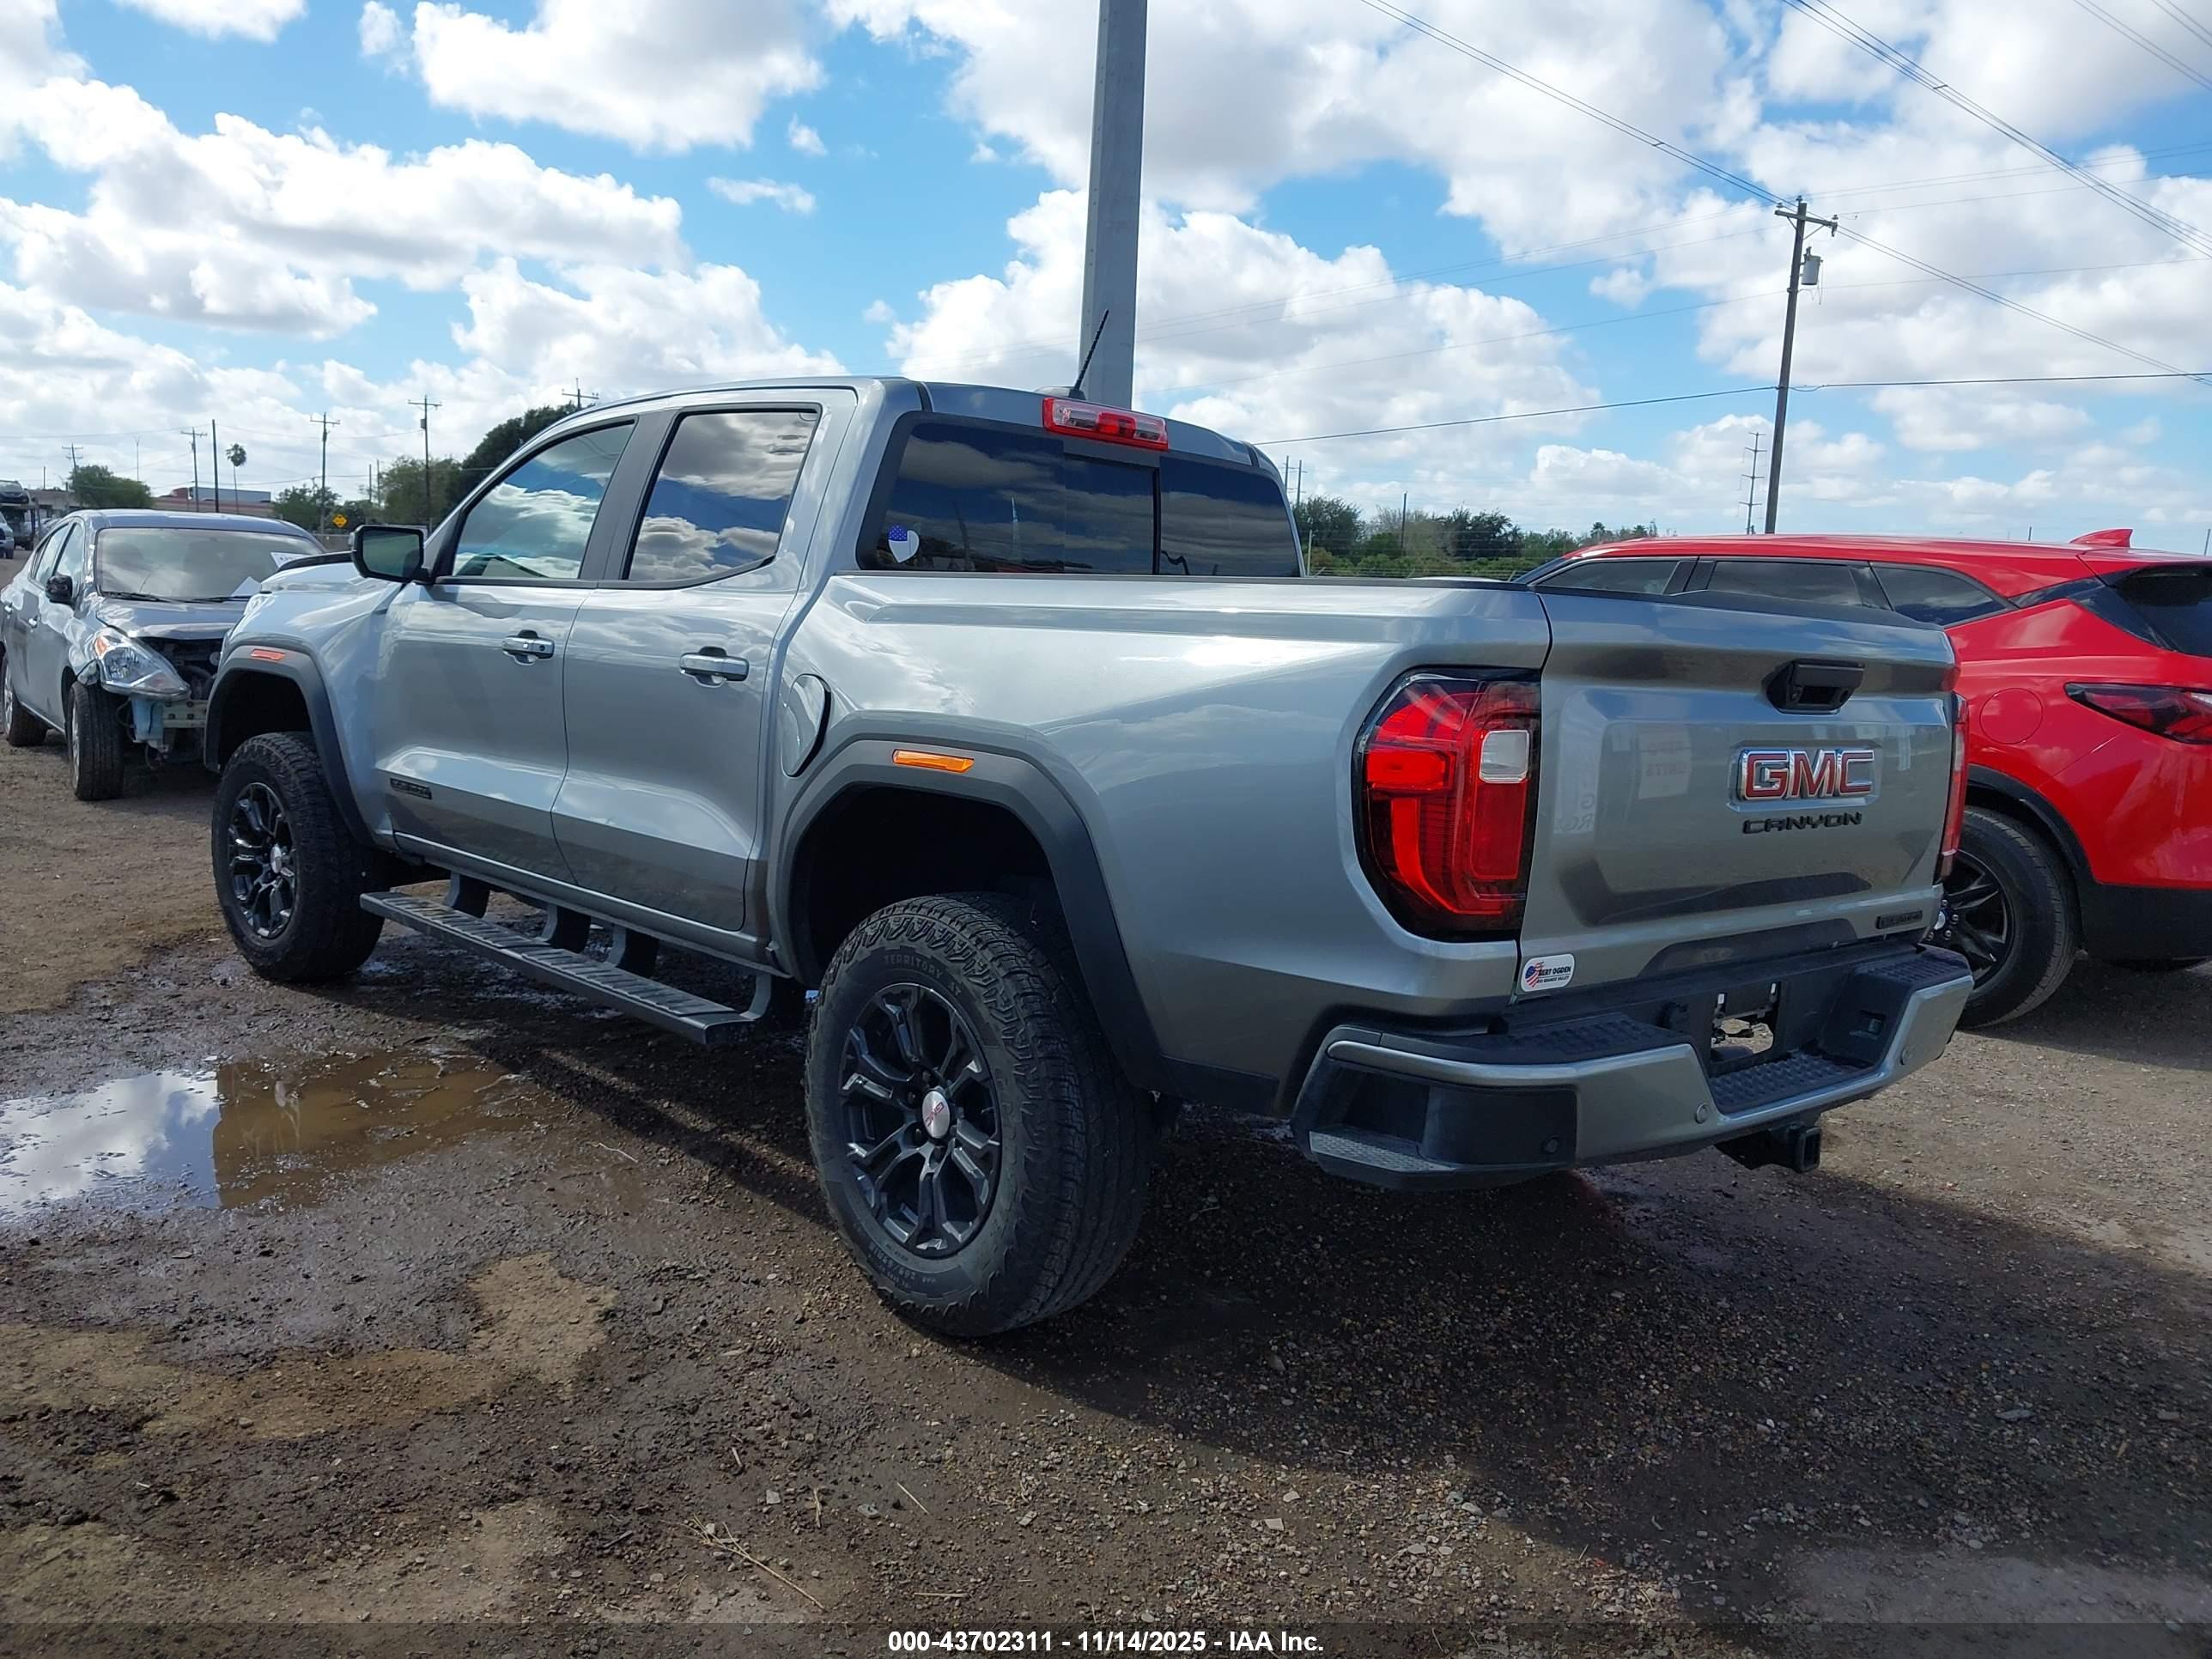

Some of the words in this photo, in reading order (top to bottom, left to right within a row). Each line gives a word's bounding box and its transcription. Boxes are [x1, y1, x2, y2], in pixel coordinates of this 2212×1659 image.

[1739, 749, 1875, 800] GMC
[1742, 811, 1863, 835] CANYON
[884, 954, 943, 979] TERRITORY
[1538, 968, 1552, 976] BERT
[925, 1102, 945, 1127] GMC
